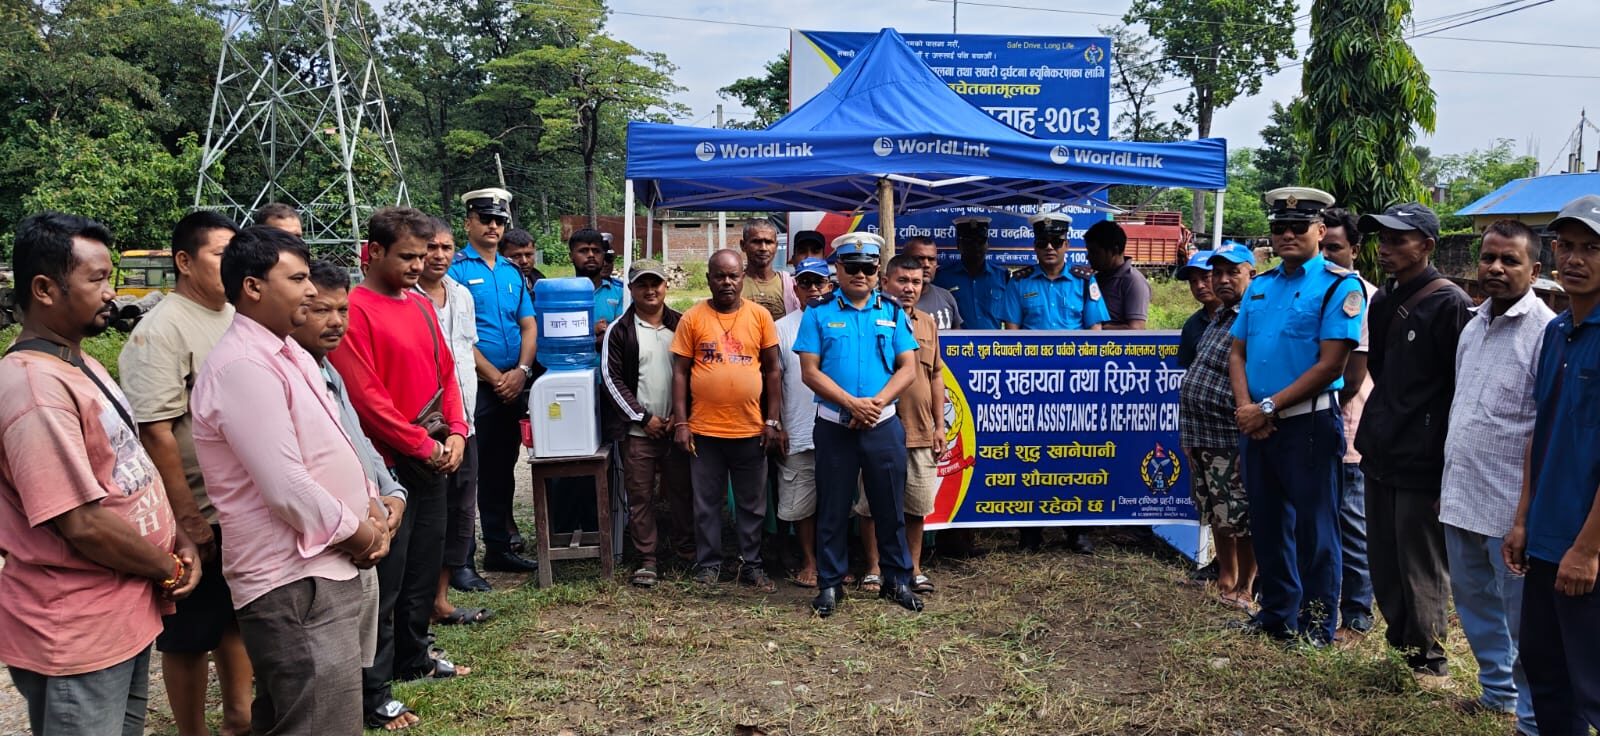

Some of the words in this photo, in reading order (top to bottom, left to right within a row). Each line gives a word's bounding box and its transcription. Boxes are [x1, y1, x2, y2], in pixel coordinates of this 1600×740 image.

[1044, 42, 1061, 50] Long
[957, 67, 972, 77] तथा
[975, 65, 998, 77] सवारी
[1000, 65, 1027, 80] दुर्घटना
[980, 106, 1100, 136] ताह-२०८३
[720, 142, 813, 159] WorldLink
[898, 139, 990, 158] WorldLink
[1074, 149, 1164, 169] WorldLink
[899, 225, 931, 239] ट्राफिक
[934, 225, 956, 238] प्रहरी
[550, 318, 568, 328] खाने
[571, 317, 587, 328] पानी
[993, 341, 1022, 356] दिपावली
[1024, 345, 1039, 356] तथा
[1056, 341, 1076, 356] पर्वको
[1100, 341, 1122, 357] हार्दिक
[1159, 345, 1180, 359] शुभक
[969, 369, 1001, 399] यात्रु
[1005, 369, 1065, 395] सहायता
[1070, 369, 1100, 394] तथा
[1104, 361, 1151, 396] रिफ्रेस
[1155, 361, 1187, 394] सेन्
[976, 403, 1035, 432] PASSENGER
[1036, 403, 1098, 432] ASSISTANCE
[1100, 403, 1107, 432] &
[1110, 403, 1157, 432] RE-FRESH
[1159, 403, 1180, 431] CEN
[979, 441, 1010, 459] यहाँ
[1046, 440, 1117, 459] खानेपानी
[985, 473, 1016, 487] तथा
[1021, 469, 1110, 487] शौचालयको
[975, 500, 1033, 514] व्यवस्था
[1039, 496, 1084, 514] रहेको
[1088, 500, 1105, 513] छ
[1119, 496, 1137, 505] जिल्ला
